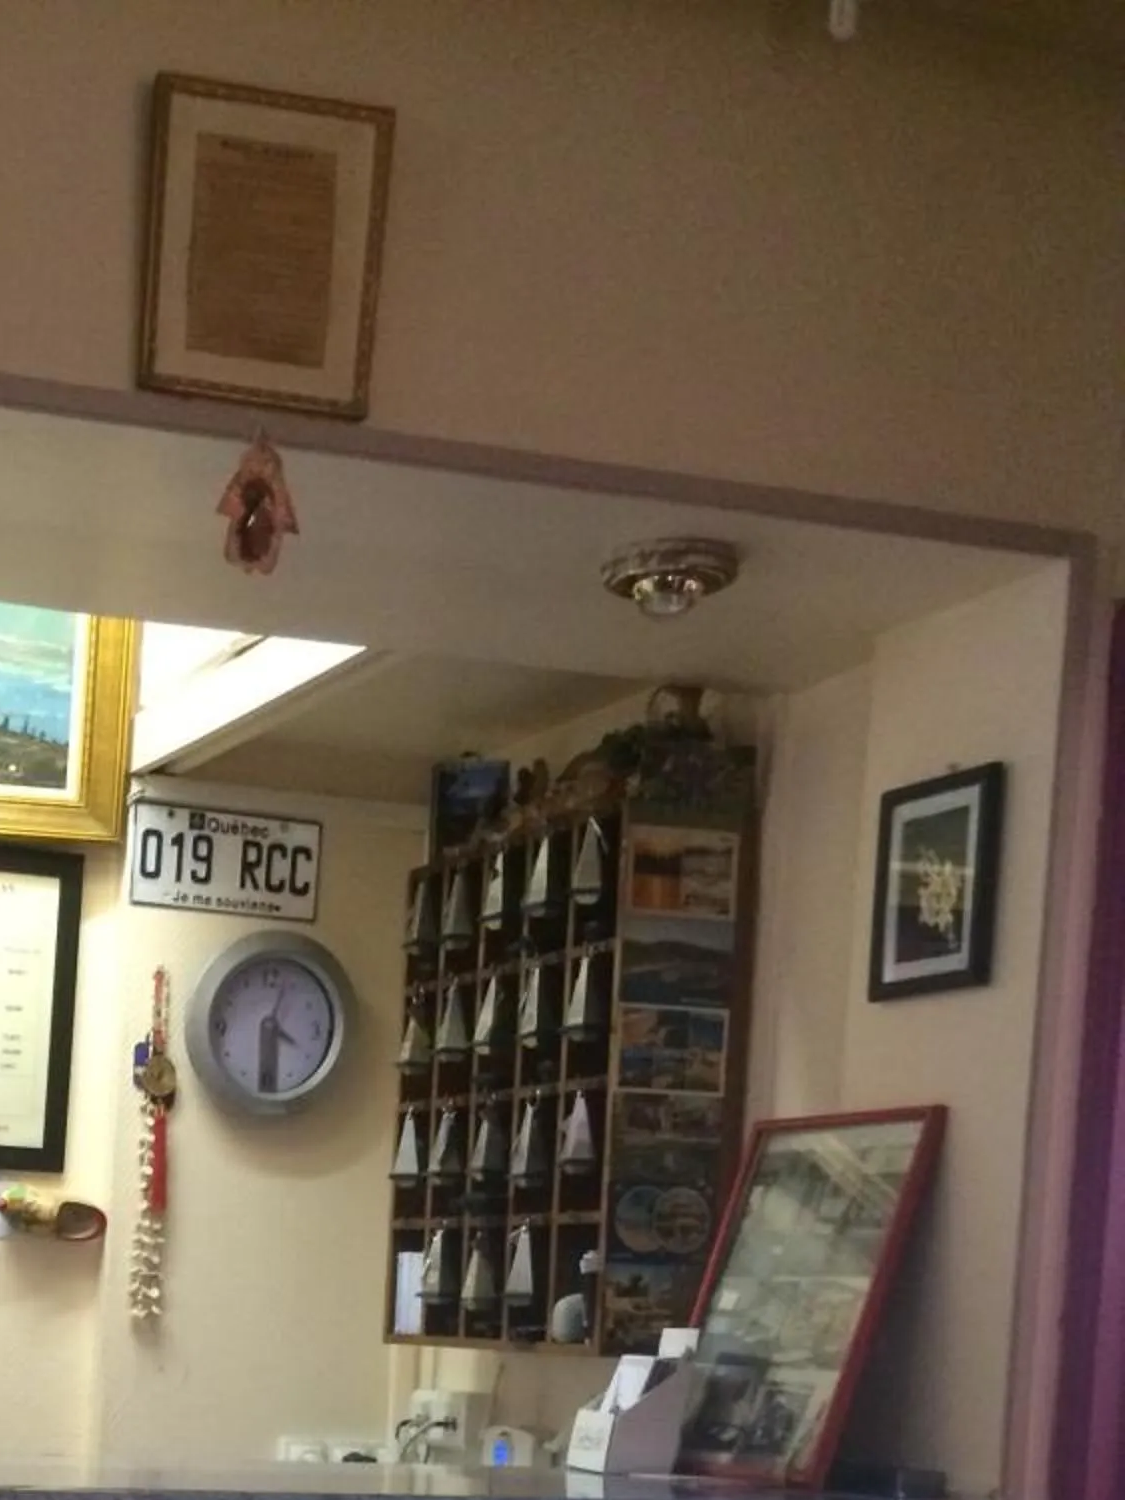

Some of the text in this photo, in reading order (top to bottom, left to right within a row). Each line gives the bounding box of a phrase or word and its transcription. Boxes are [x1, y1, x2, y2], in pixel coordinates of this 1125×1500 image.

[206, 816, 270, 839] Québec
[139, 828, 313, 897] 019 RCC
[193, 894, 212, 906] me
